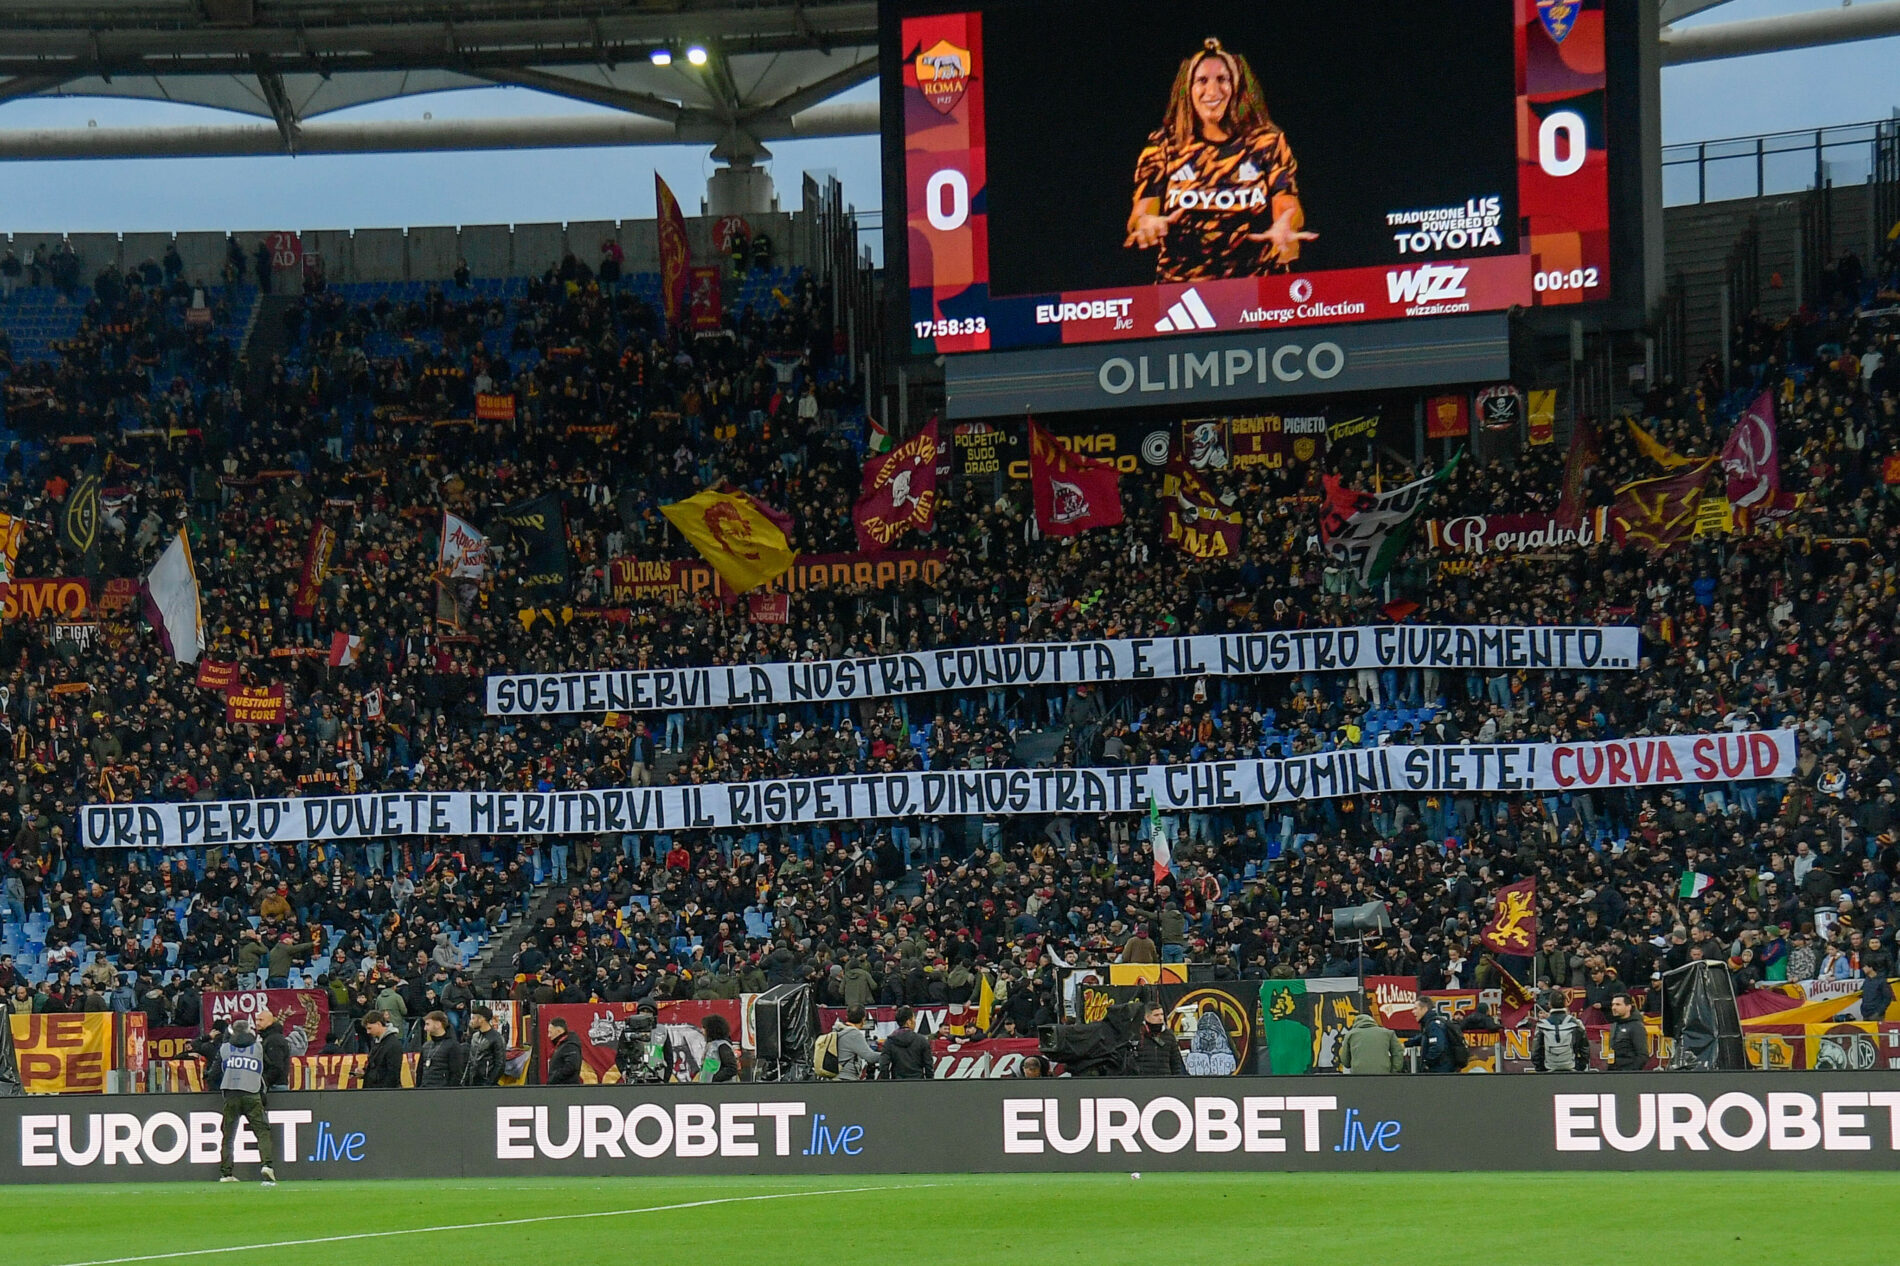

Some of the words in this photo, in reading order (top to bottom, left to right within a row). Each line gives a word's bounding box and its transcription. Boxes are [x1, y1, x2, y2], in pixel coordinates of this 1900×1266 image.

[925, 82, 963, 94] ROMA
[1539, 111, 1586, 177] 0
[926, 169, 968, 231] 0
[1168, 188, 1266, 210] TOYOTA
[1386, 206, 1466, 226] TRADUZIONE
[1466, 196, 1500, 217] LIS
[1421, 217, 1482, 232] POWERED
[1483, 214, 1501, 227] BY
[274, 234, 291, 250] 21
[1394, 226, 1502, 255] TOYOTA
[272, 251, 295, 265] AD
[1386, 264, 1469, 305] WIZZ
[1533, 268, 1598, 293] 00:02
[1036, 298, 1132, 325] EUROBET
[1239, 307, 1295, 324] Auberge
[1296, 301, 1364, 319] Collection
[1406, 303, 1470, 316] wizzair.com
[914, 317, 986, 338] 17:58:33
[1099, 341, 1346, 395] OLIMPICO
[1232, 417, 1281, 434] SENATO
[1284, 417, 1326, 434] PIGNETO
[954, 431, 1006, 447] POLPETTA
[1252, 436, 1261, 452] E
[967, 447, 995, 460] SUDO
[964, 459, 999, 473] DRAGO
[618, 560, 672, 583] ULTRAS
[497, 669, 712, 714] SOSTENERVI
[728, 667, 773, 704] LA
[789, 655, 927, 702] NOSTRA
[935, 643, 1117, 688] CONDOTTA
[1131, 640, 1154, 678] E
[1173, 638, 1205, 675] IL
[1219, 629, 1359, 674] NOSTRO
[1374, 626, 1630, 668] GIURAMENTO...
[228, 696, 282, 708] QUESTIONE
[235, 708, 249, 719] DE
[250, 709, 277, 721] CORE
[87, 805, 164, 846] ORA
[177, 801, 290, 844] PERO'
[303, 794, 451, 839] DOVETE
[469, 790, 665, 834] MERITARVI
[681, 787, 714, 828] IL
[728, 775, 917, 825] RISPETTO,
[921, 768, 1151, 814] DIMOSTRATE
[1165, 764, 1241, 807] CHE
[1256, 750, 1391, 801] UOMINI
[1404, 747, 1536, 790] SIETE!
[1552, 741, 1683, 787] CURVA
[1692, 733, 1780, 780] SUD
[212, 992, 270, 1014] AMOR
[496, 1102, 806, 1159] EUROBET
[802, 1114, 865, 1156] .live
[1002, 1095, 1338, 1154] EUROBET
[1333, 1108, 1401, 1152] .live
[20, 1110, 312, 1167] EUROBET
[307, 1121, 366, 1163] .live
